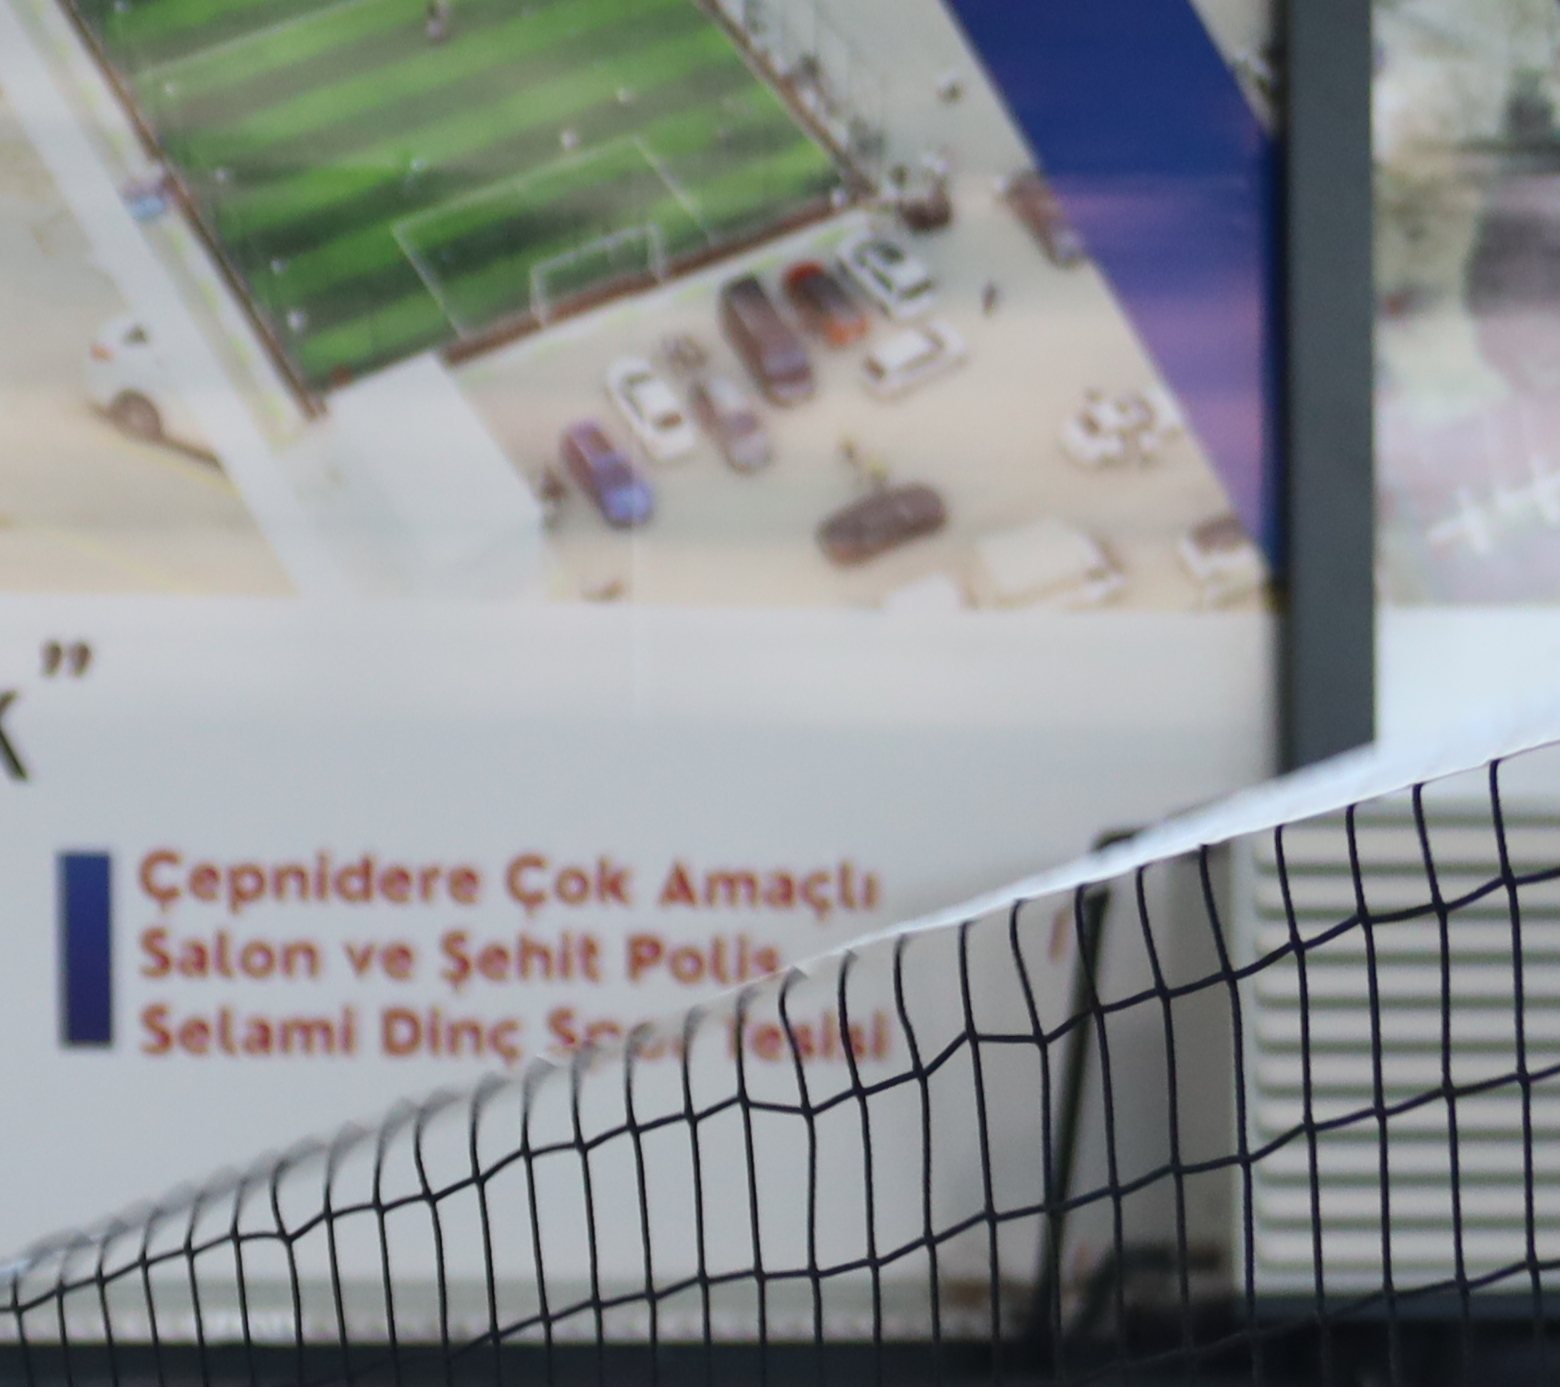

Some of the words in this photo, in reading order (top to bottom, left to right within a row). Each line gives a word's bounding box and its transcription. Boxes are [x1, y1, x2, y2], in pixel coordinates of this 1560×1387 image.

[139, 848, 480, 913] Çepnidere
[505, 854, 629, 914] Çok
[659, 861, 878, 919] Amaçlı
[140, 926, 320, 980] Salon
[347, 941, 415, 981] ve
[441, 930, 601, 988] Şehit
[626, 933, 782, 985] Polis
[140, 1004, 357, 1056] Selami
[380, 1007, 520, 1065] Dinç
